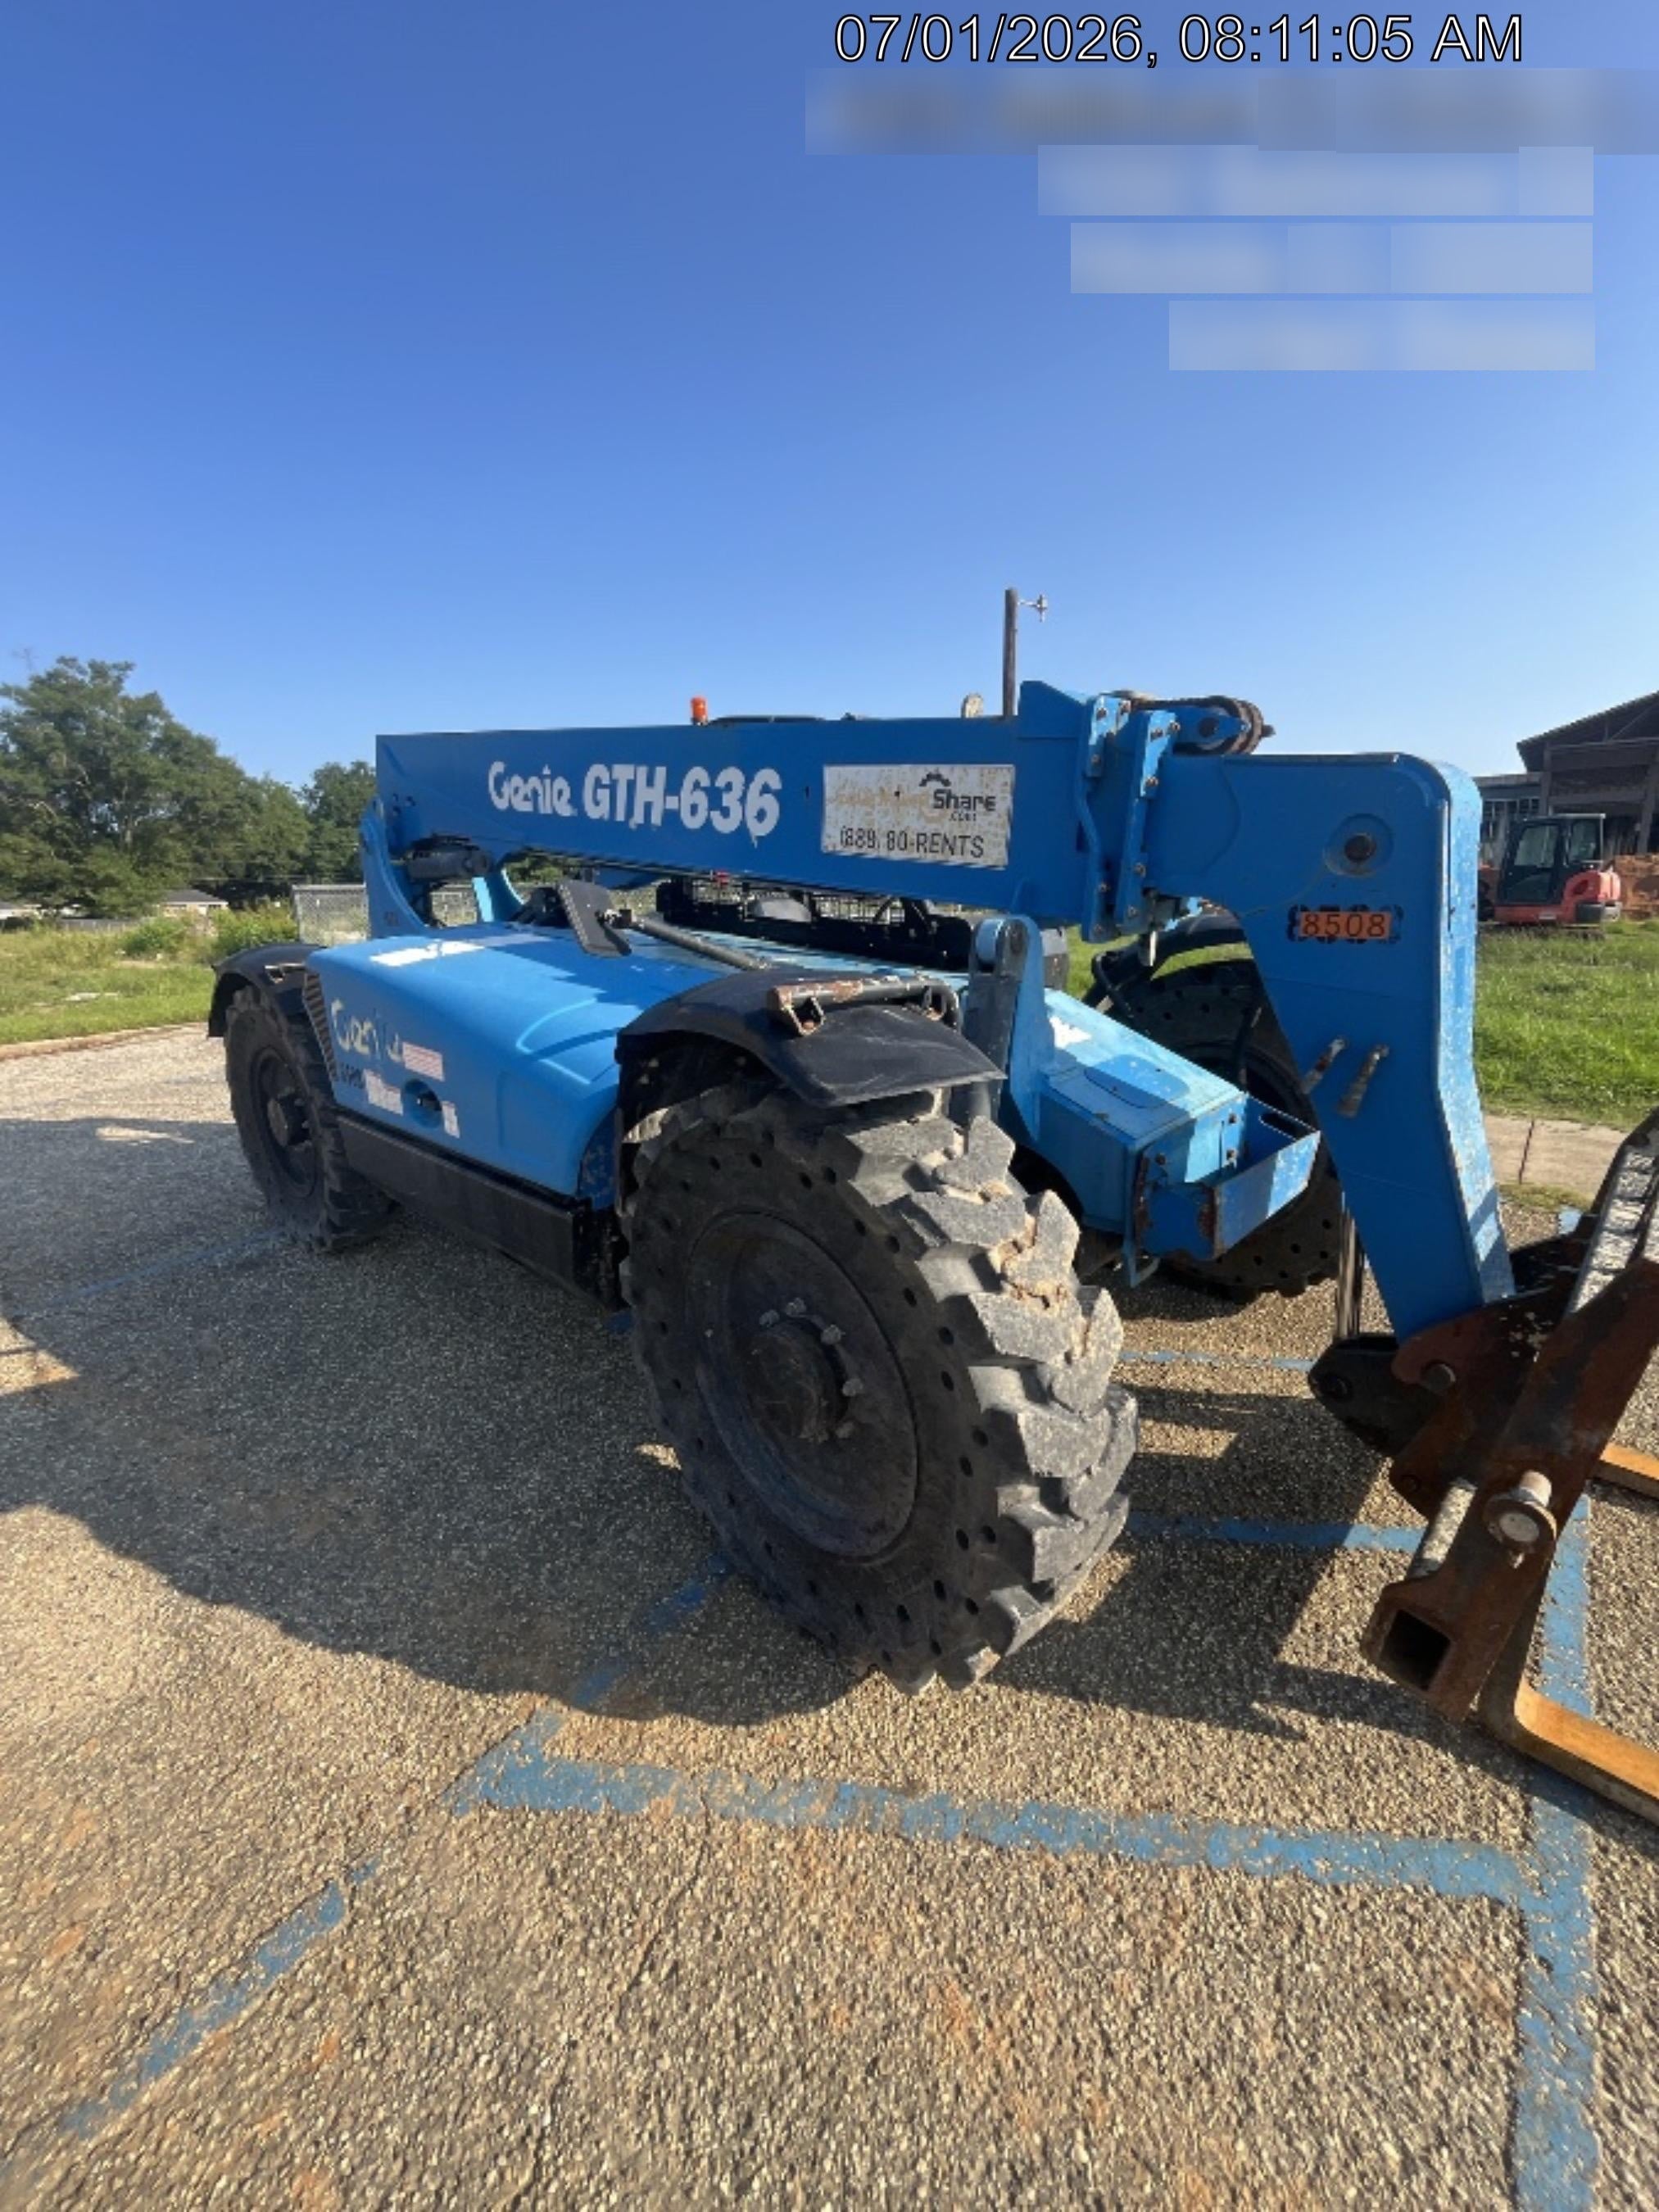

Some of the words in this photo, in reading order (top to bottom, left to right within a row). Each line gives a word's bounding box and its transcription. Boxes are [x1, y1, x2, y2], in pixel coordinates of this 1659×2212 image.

[488, 761, 575, 818] Genie
[583, 764, 782, 839] GTH-636
[933, 789, 996, 812] Share
[886, 829, 985, 859] 80-RENTS
[1302, 913, 1386, 937] 8508
